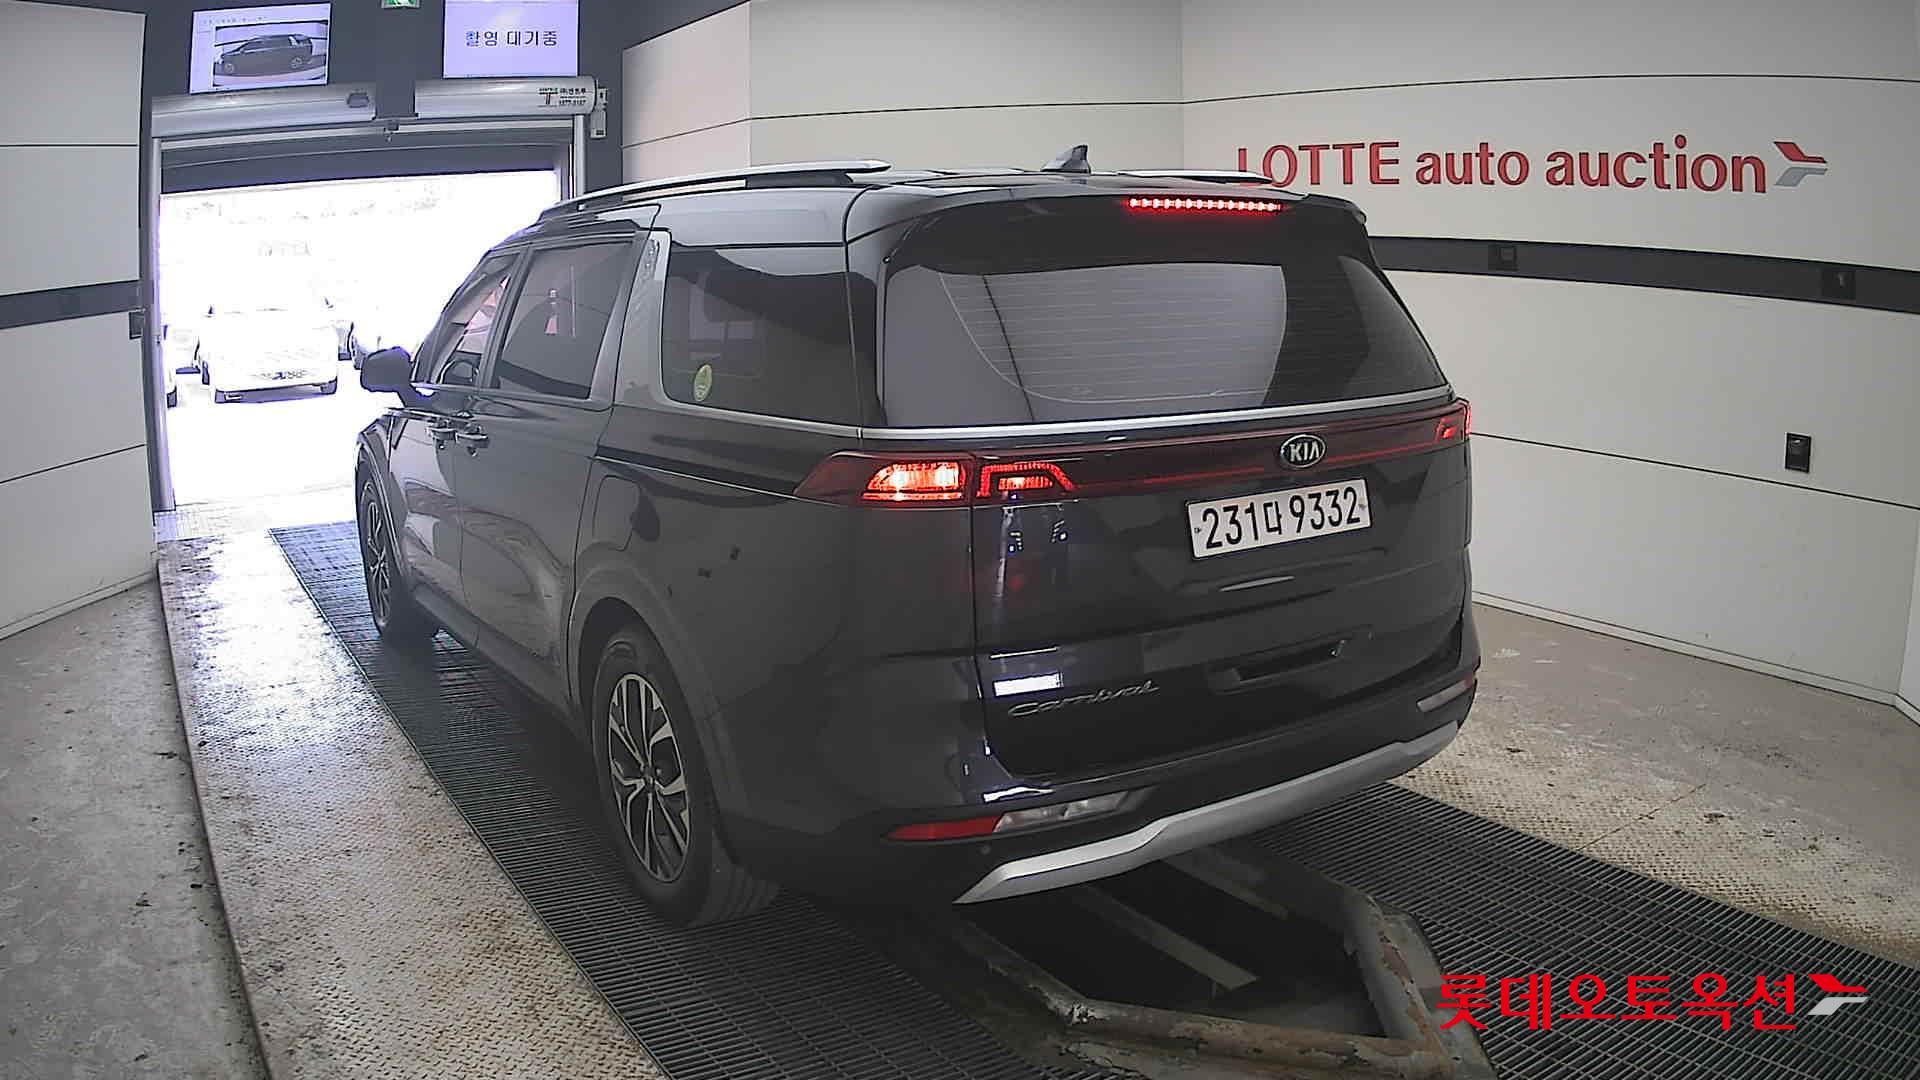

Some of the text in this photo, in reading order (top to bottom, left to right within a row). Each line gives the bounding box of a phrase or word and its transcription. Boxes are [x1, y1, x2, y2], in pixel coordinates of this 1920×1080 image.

[507, 31, 557, 46] 대기중
[1238, 134, 1766, 193] LOTTE auto auction
[1289, 440, 1320, 463] KIA
[1007, 680, 1160, 717] Carnival
